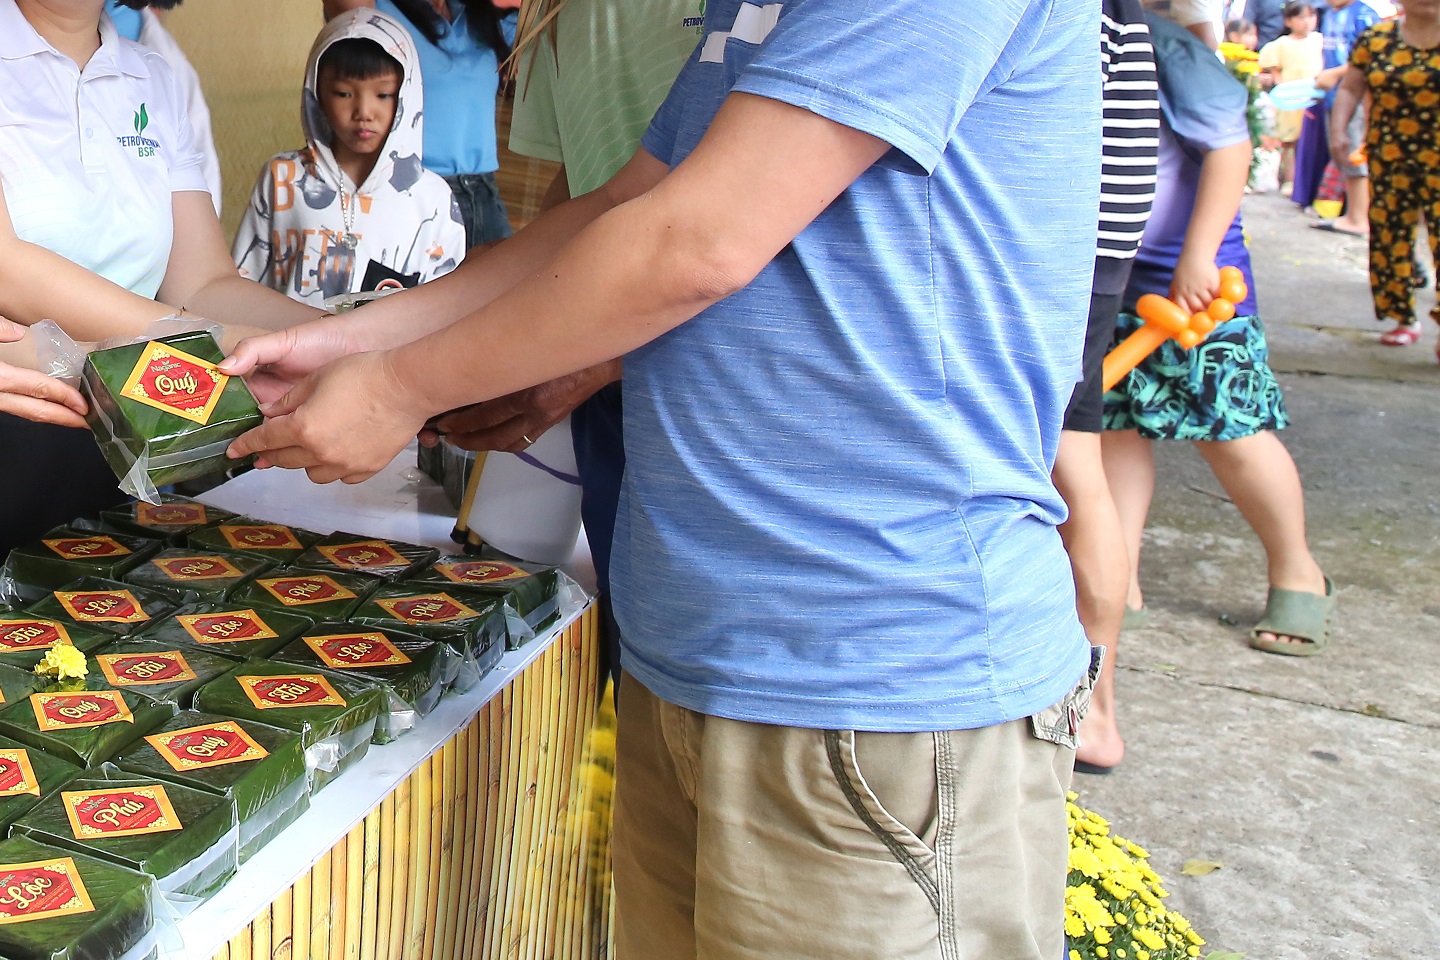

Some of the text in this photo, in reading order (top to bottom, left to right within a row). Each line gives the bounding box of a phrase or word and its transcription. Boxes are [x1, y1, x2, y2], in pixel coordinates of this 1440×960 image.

[137, 146, 155, 157] BSR
[155, 370, 198, 395] Quý
[59, 699, 101, 720] Quý
[186, 733, 227, 758] Quý
[92, 797, 146, 827] Phú
[0, 875, 53, 910] Lộc
